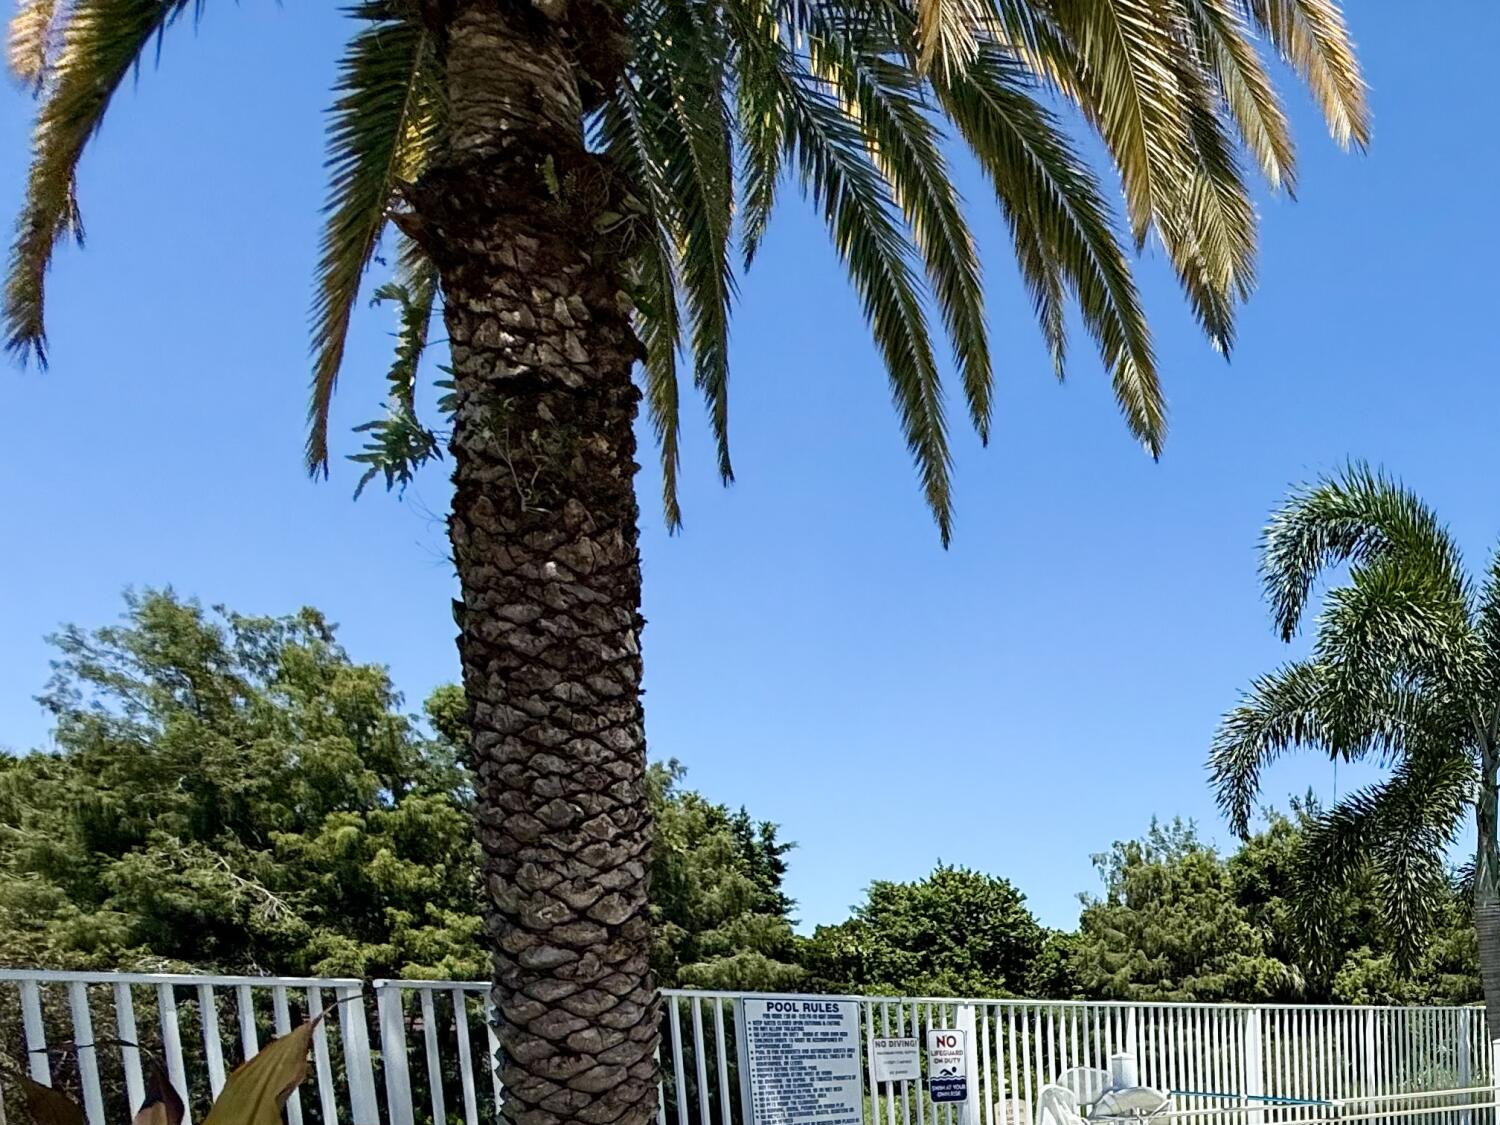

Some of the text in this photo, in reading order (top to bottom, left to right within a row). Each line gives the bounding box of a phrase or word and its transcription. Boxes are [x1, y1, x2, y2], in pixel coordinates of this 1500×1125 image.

[766, 1002, 840, 1013] POOL RULES
[875, 1040, 887, 1048] NO
[936, 1035, 957, 1048] NO
